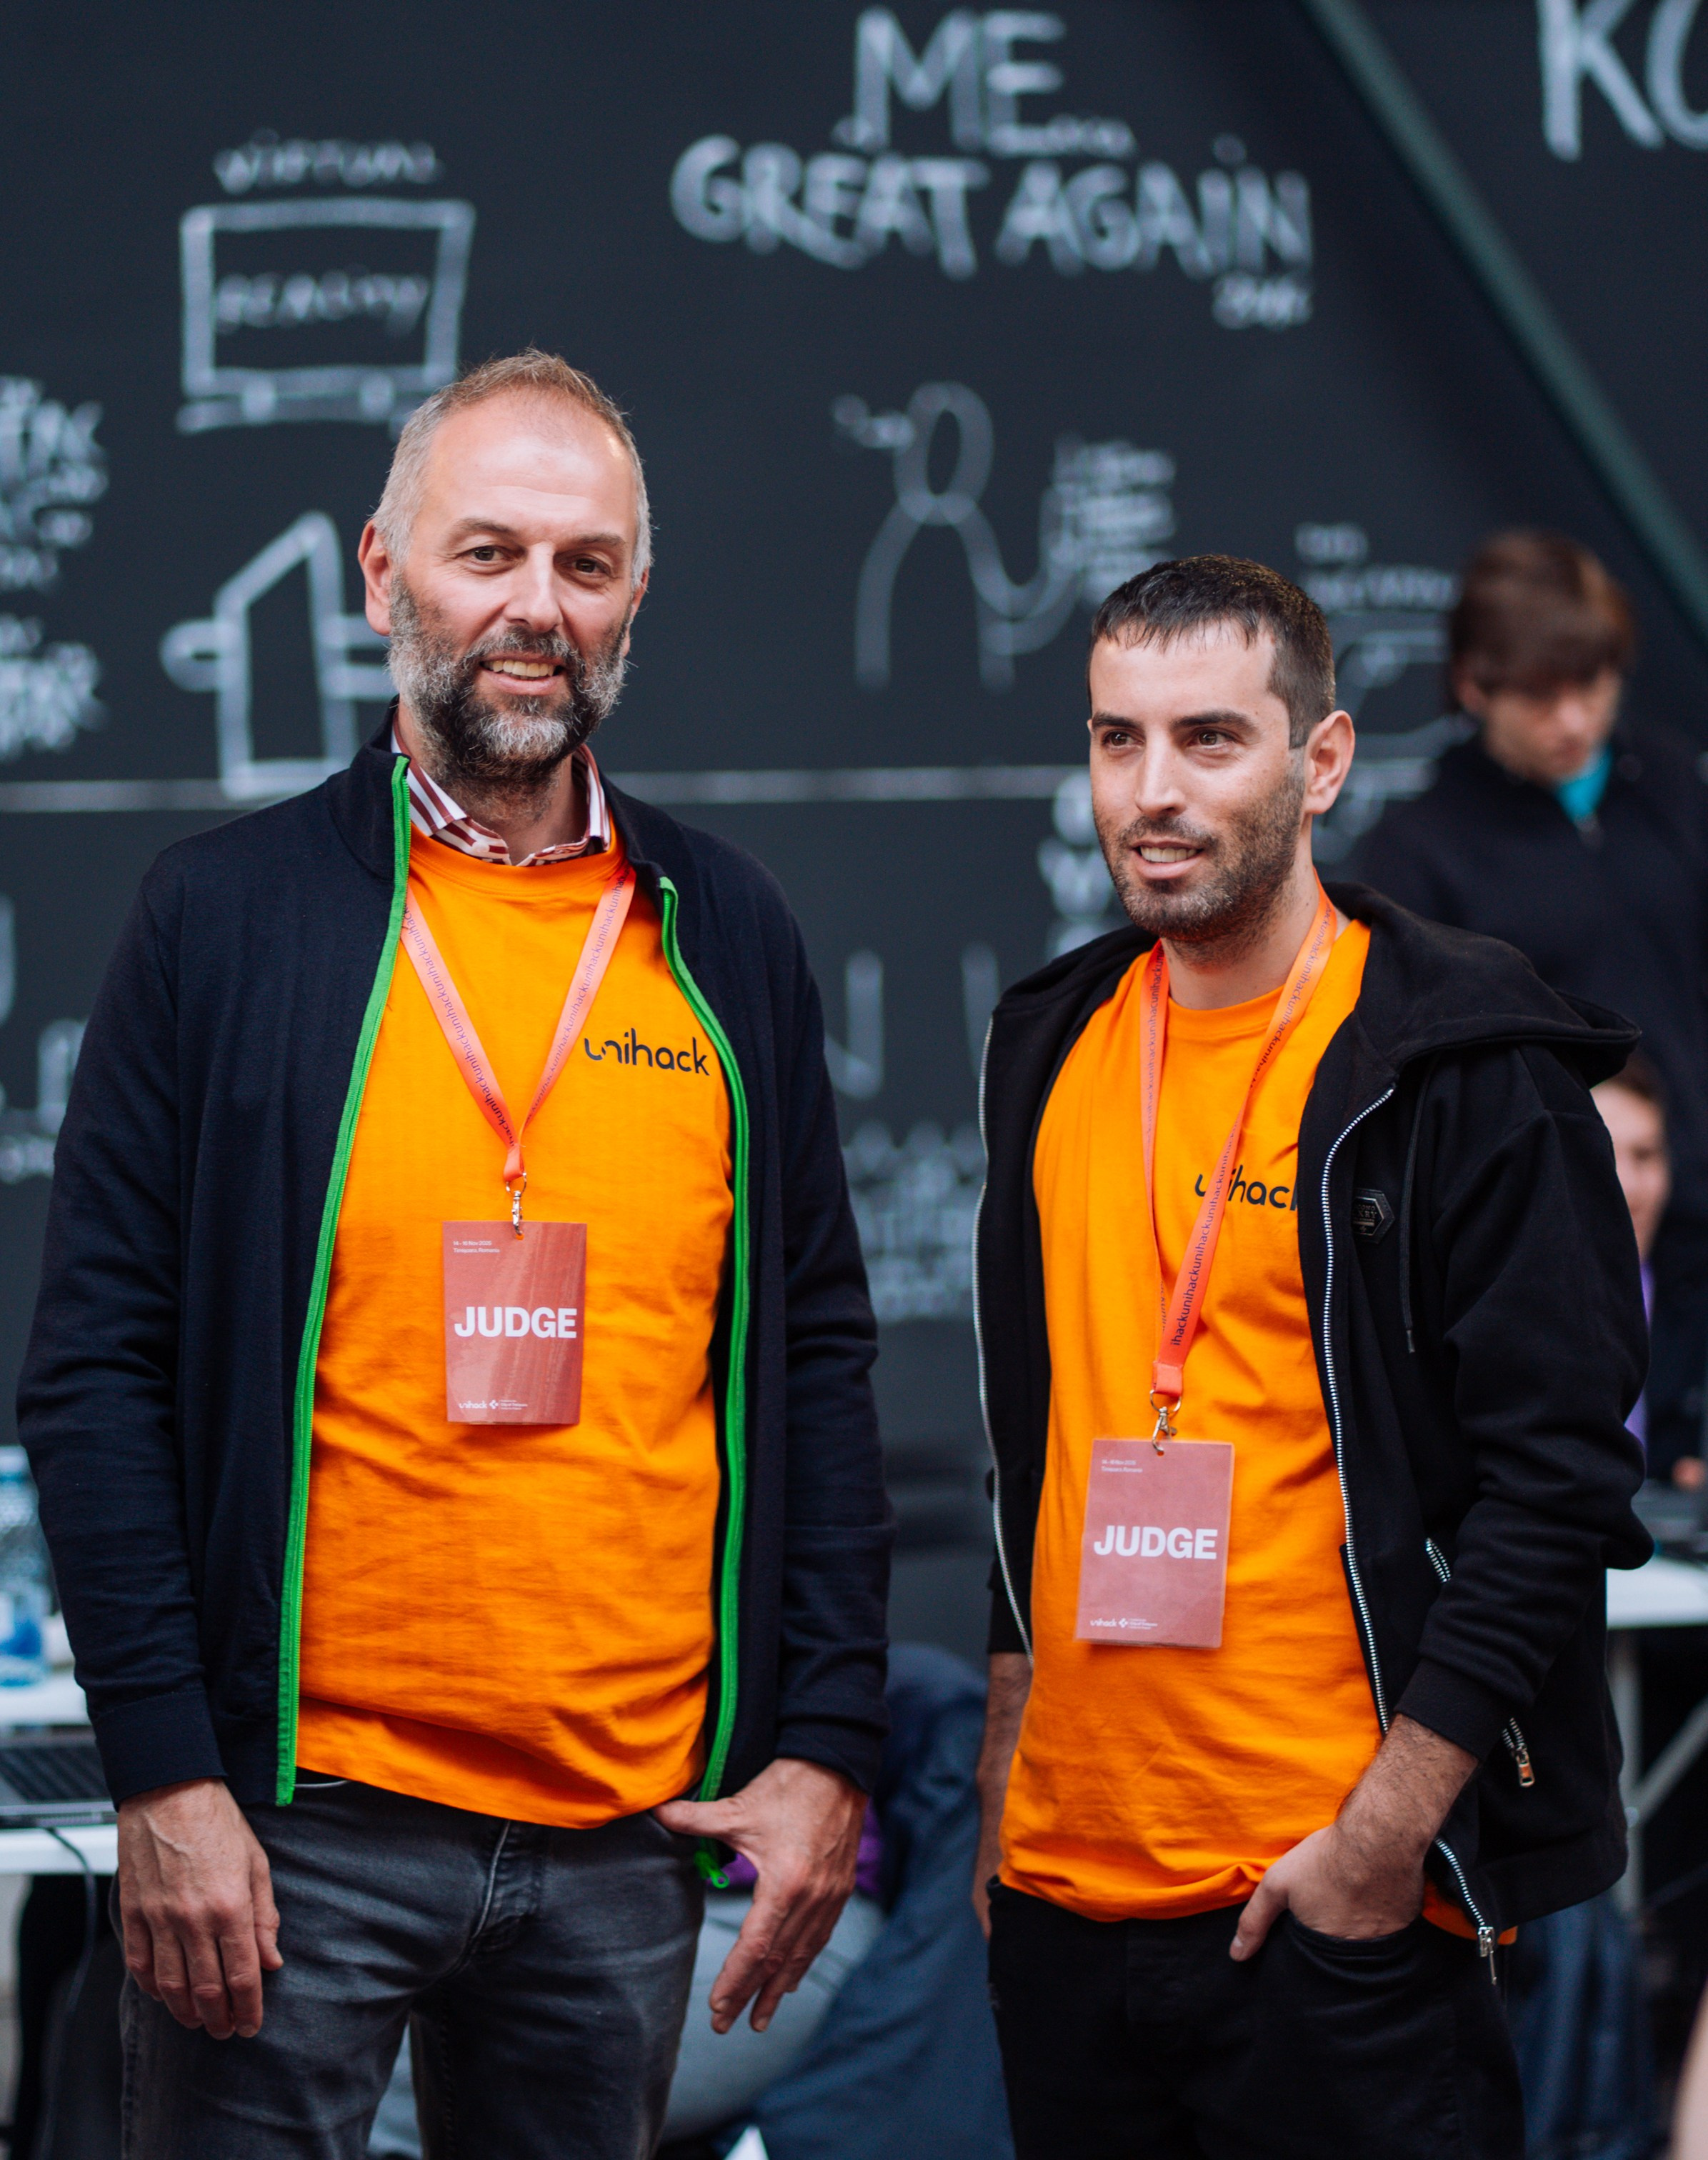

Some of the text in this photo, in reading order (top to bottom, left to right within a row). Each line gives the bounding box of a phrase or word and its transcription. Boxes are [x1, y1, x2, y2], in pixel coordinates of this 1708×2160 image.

[855, 7, 1066, 156] ME
[670, 136, 990, 280] GREAT
[584, 1027, 711, 1076] unihack
[1194, 1164, 1298, 1211] uihac
[454, 1306, 577, 1339] JUDGE
[1094, 1525, 1218, 1559] JUDGE
